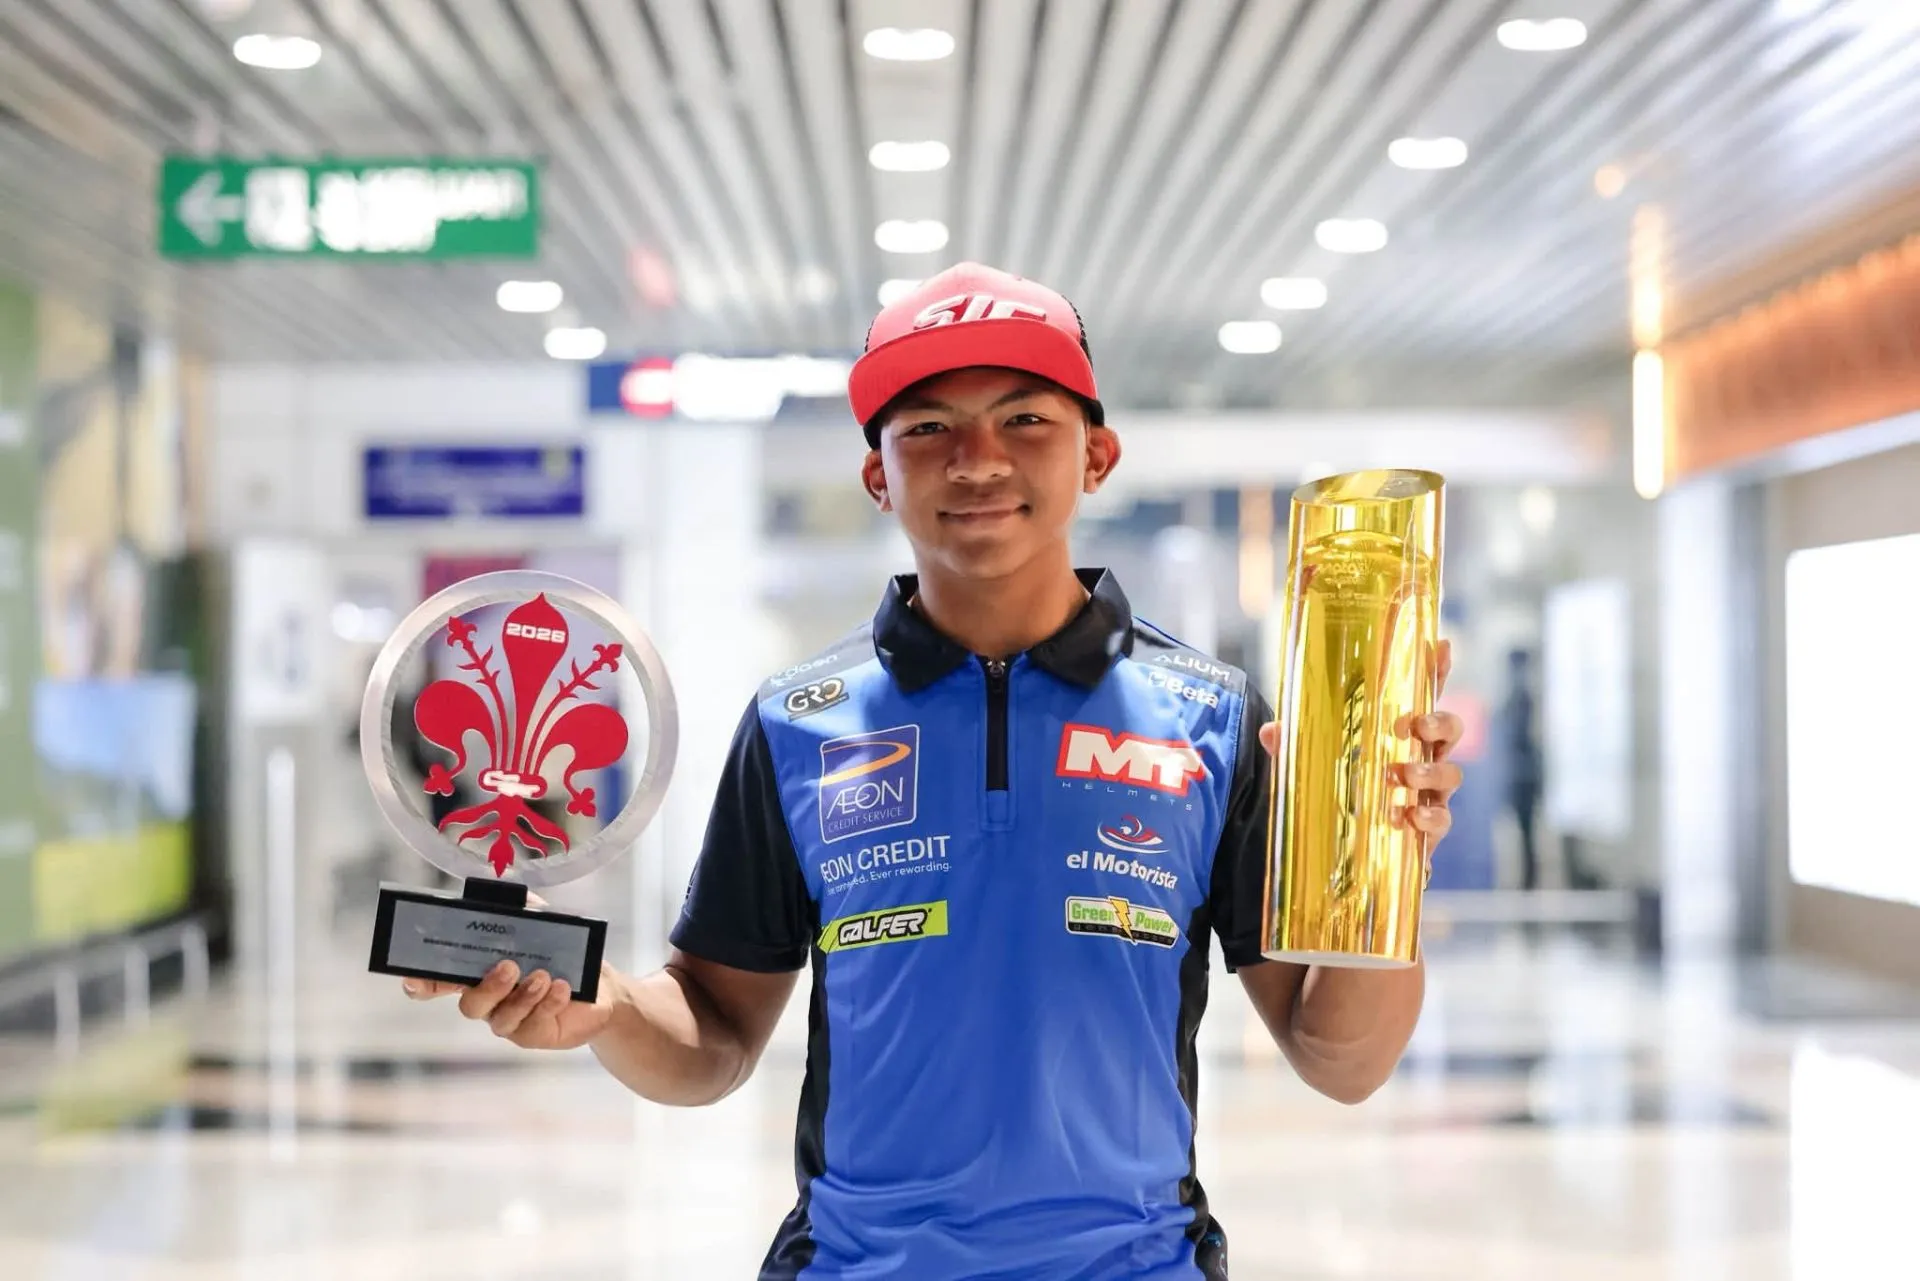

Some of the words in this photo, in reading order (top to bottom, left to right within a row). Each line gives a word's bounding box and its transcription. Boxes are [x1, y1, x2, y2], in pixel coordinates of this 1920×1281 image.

[1166, 677, 1219, 709] Beta
[1063, 728, 1202, 790] MT
[1062, 780, 1194, 811] HELMETS
[828, 815, 860, 834] CREDIT
[862, 806, 904, 825] SERVICE
[857, 835, 951, 870] CREDIT
[869, 869, 892, 881] Ever
[895, 861, 952, 877] rewarding.
[1066, 851, 1089, 869] el
[1093, 851, 1179, 889] Motorista
[840, 911, 925, 944] GALFER
[1071, 903, 1115, 921] Green
[1135, 911, 1174, 934] Power
